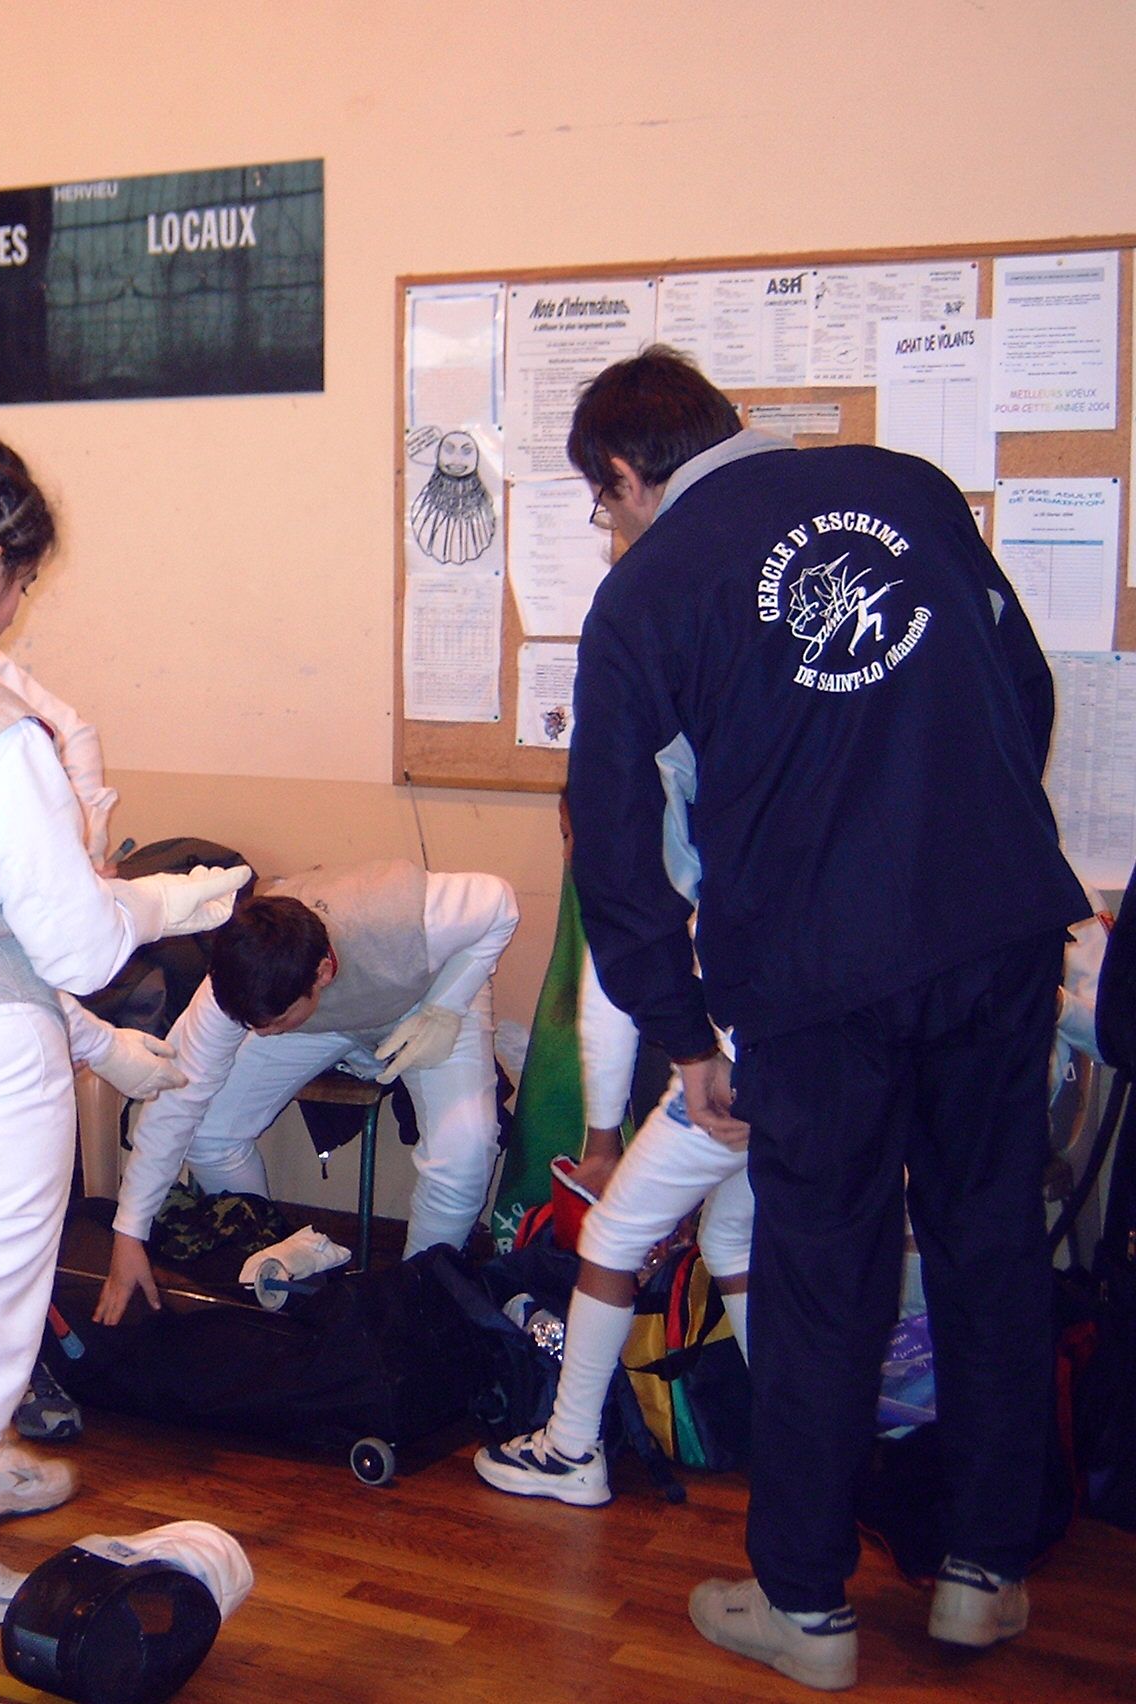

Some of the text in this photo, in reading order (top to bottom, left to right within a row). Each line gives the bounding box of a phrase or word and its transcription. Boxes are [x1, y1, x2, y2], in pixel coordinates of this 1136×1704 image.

[146, 205, 256, 255] LOCAUX
[895, 330, 975, 354] ACHAT DE VOLANTS
[758, 542, 796, 622] CERCLE
[812, 511, 910, 558] ESCRIME
[793, 606, 933, 693] DE SAINT-LO (Manche)
